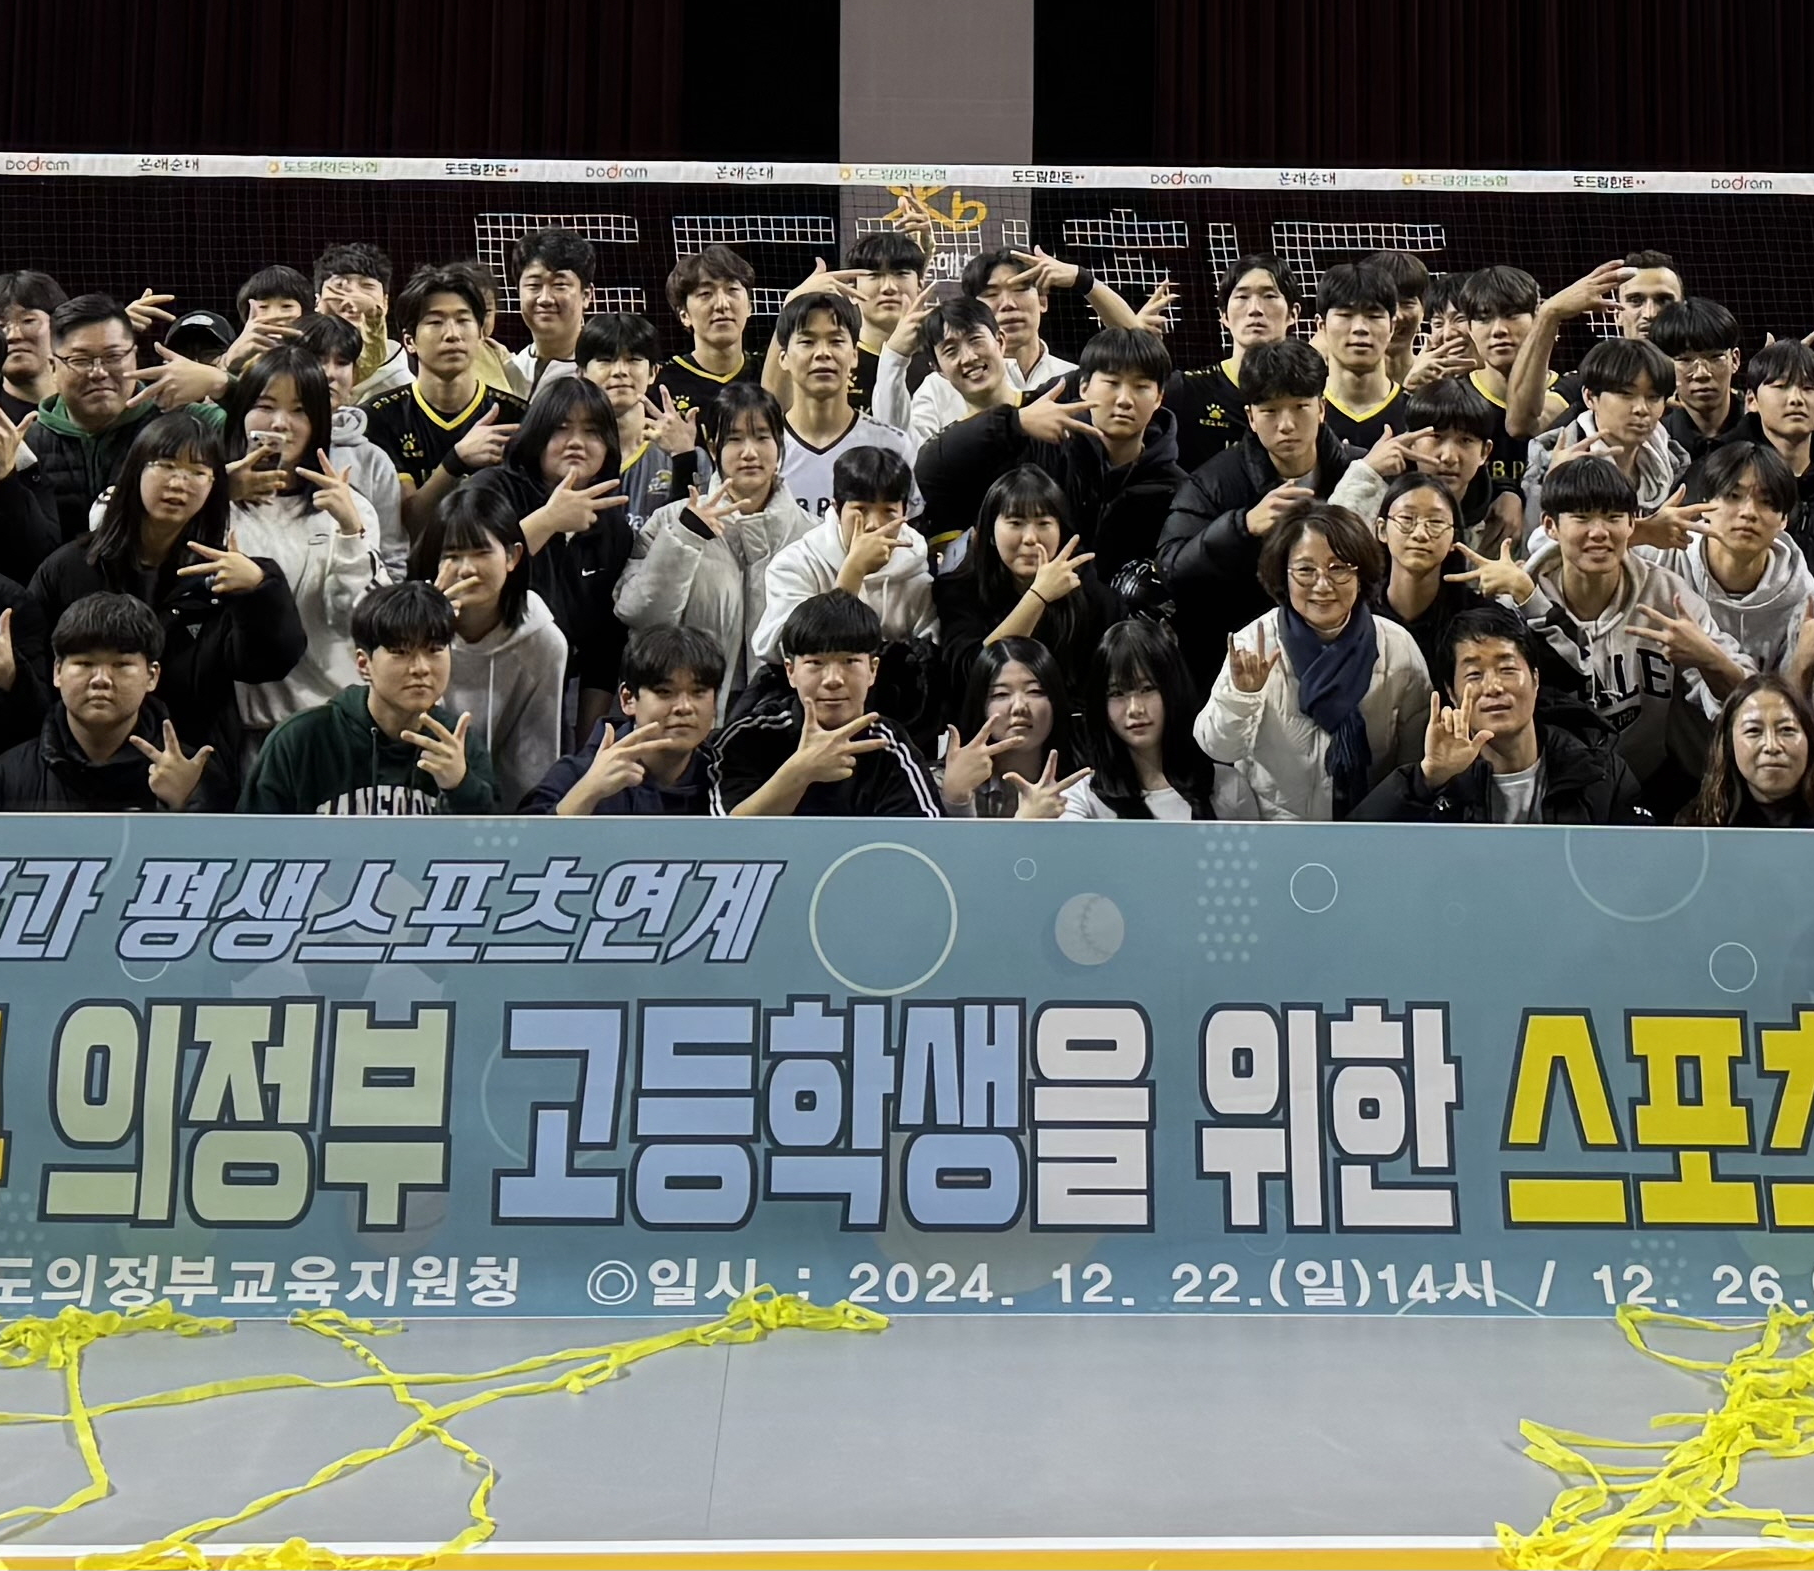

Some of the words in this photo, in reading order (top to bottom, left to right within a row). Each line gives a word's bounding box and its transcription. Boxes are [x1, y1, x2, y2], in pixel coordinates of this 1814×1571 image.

[444, 162, 508, 177] 도드람한돈
[1012, 170, 1074, 184] 도드람한돈
[1573, 175, 1634, 189] 도드람한돈
[116, 857, 785, 966] 평생스포츠연계
[38, 997, 456, 1232] 의정부
[489, 995, 1155, 1232] 고등학생을
[1195, 998, 1463, 1233] 위한
[646, 1255, 756, 1308] 일시
[848, 1262, 1015, 1308] 2024.
[1051, 1262, 1135, 1308] 12.
[1593, 1264, 1679, 1308] 12.
